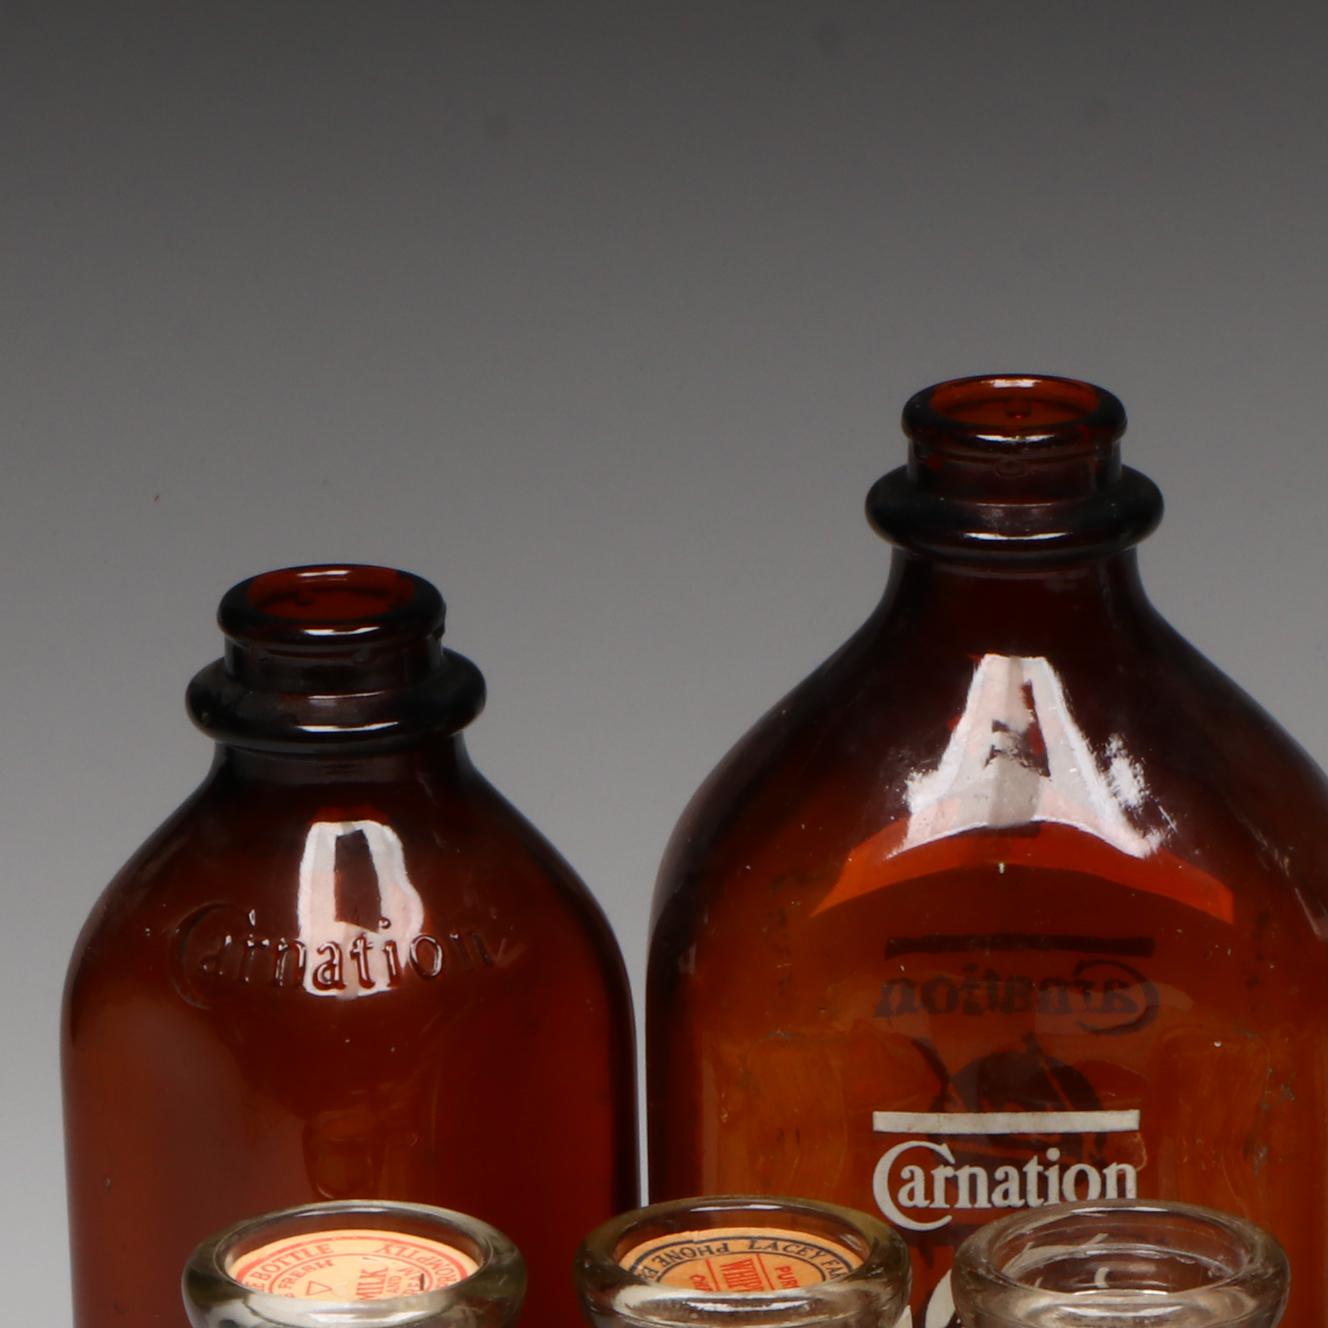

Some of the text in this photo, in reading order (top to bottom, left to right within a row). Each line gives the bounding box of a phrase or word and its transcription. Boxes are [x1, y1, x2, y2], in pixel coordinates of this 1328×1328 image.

[872, 1140, 1139, 1231] Carnation
[251, 1243, 334, 1281] BOTTLE
[653, 1242, 731, 1269] PHONE
[748, 1239, 823, 1262] LACEY
[356, 1267, 389, 1301] MILK
